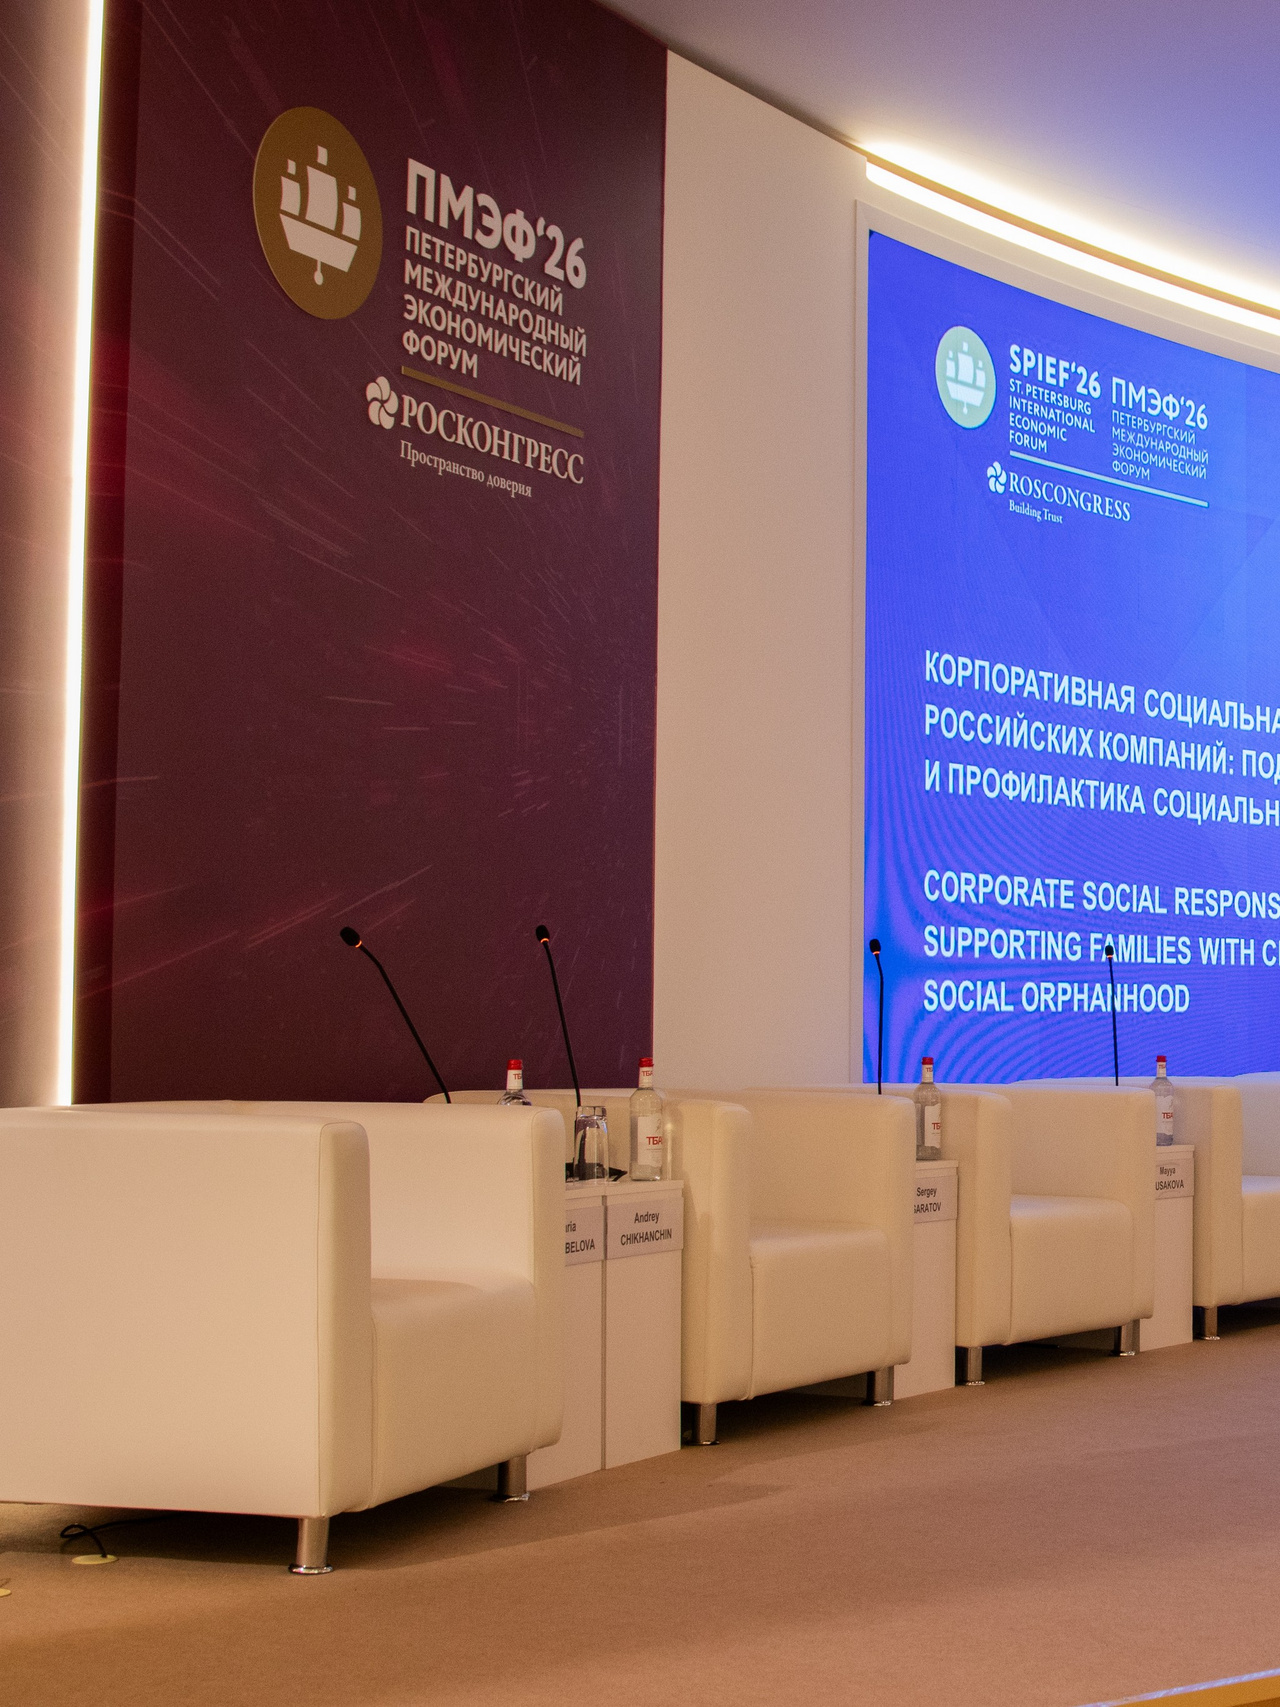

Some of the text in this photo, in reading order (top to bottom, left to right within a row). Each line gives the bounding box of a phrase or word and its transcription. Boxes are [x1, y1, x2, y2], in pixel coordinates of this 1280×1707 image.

[406, 226, 562, 316] ПЕТЕРБУРГСКИЙ
[405, 259, 586, 357] МЕЖДУНАРОДНЫЙ
[403, 331, 477, 378] ФОРУМ
[404, 294, 580, 385] ЭКОНОМИЧЕСКИЙ
[1010, 378, 1091, 414] ST. PETERSBURG
[1010, 396, 1095, 432] INTERNATIONAL
[401, 395, 584, 484] РОСКОНГРЕСС
[1010, 412, 1067, 441] ECONOMIC
[1010, 430, 1046, 452] FORUM
[1112, 410, 1195, 445] ПЕТЕРБУРГСКИЙ
[1112, 426, 1208, 464] МЕЖДУНАРОДНЫЙ
[1112, 443, 1206, 479] ЭКОНОМИЧЕСКИЙ
[400, 440, 532, 497] Пространство доверия
[1112, 460, 1149, 480] ФОРУМ
[1010, 472, 1130, 521] ROSCONGRESS
[1010, 500, 1062, 523] Building Trust
[926, 650, 1134, 714] КОРПОРАТИВНАЯ
[926, 704, 1093, 757] РОССИЙСКИХ
[1100, 730, 1233, 774] КОМПАНИЙ:
[925, 760, 940, 791] И
[949, 763, 1145, 813] ПРОФИЛАКТИКА
[924, 870, 1074, 909] CORPORATE
[1083, 881, 1167, 914] SOCIAL
[924, 926, 1081, 961] SUPPORTING
[1090, 933, 1191, 964] FAMILIES
[1199, 938, 1254, 965] WITH
[924, 980, 1189, 1012] SOCIAL ORPHANHOOD
[1155, 1180, 1184, 1190] USAKOVA
[1160, 1166, 1176, 1176] Mayya
[917, 1187, 937, 1198] Sergey
[634, 1211, 660, 1224] Andrey
[565, 1239, 595, 1254] BELOVA
[620, 1228, 673, 1246] CHIKHANCHIN
